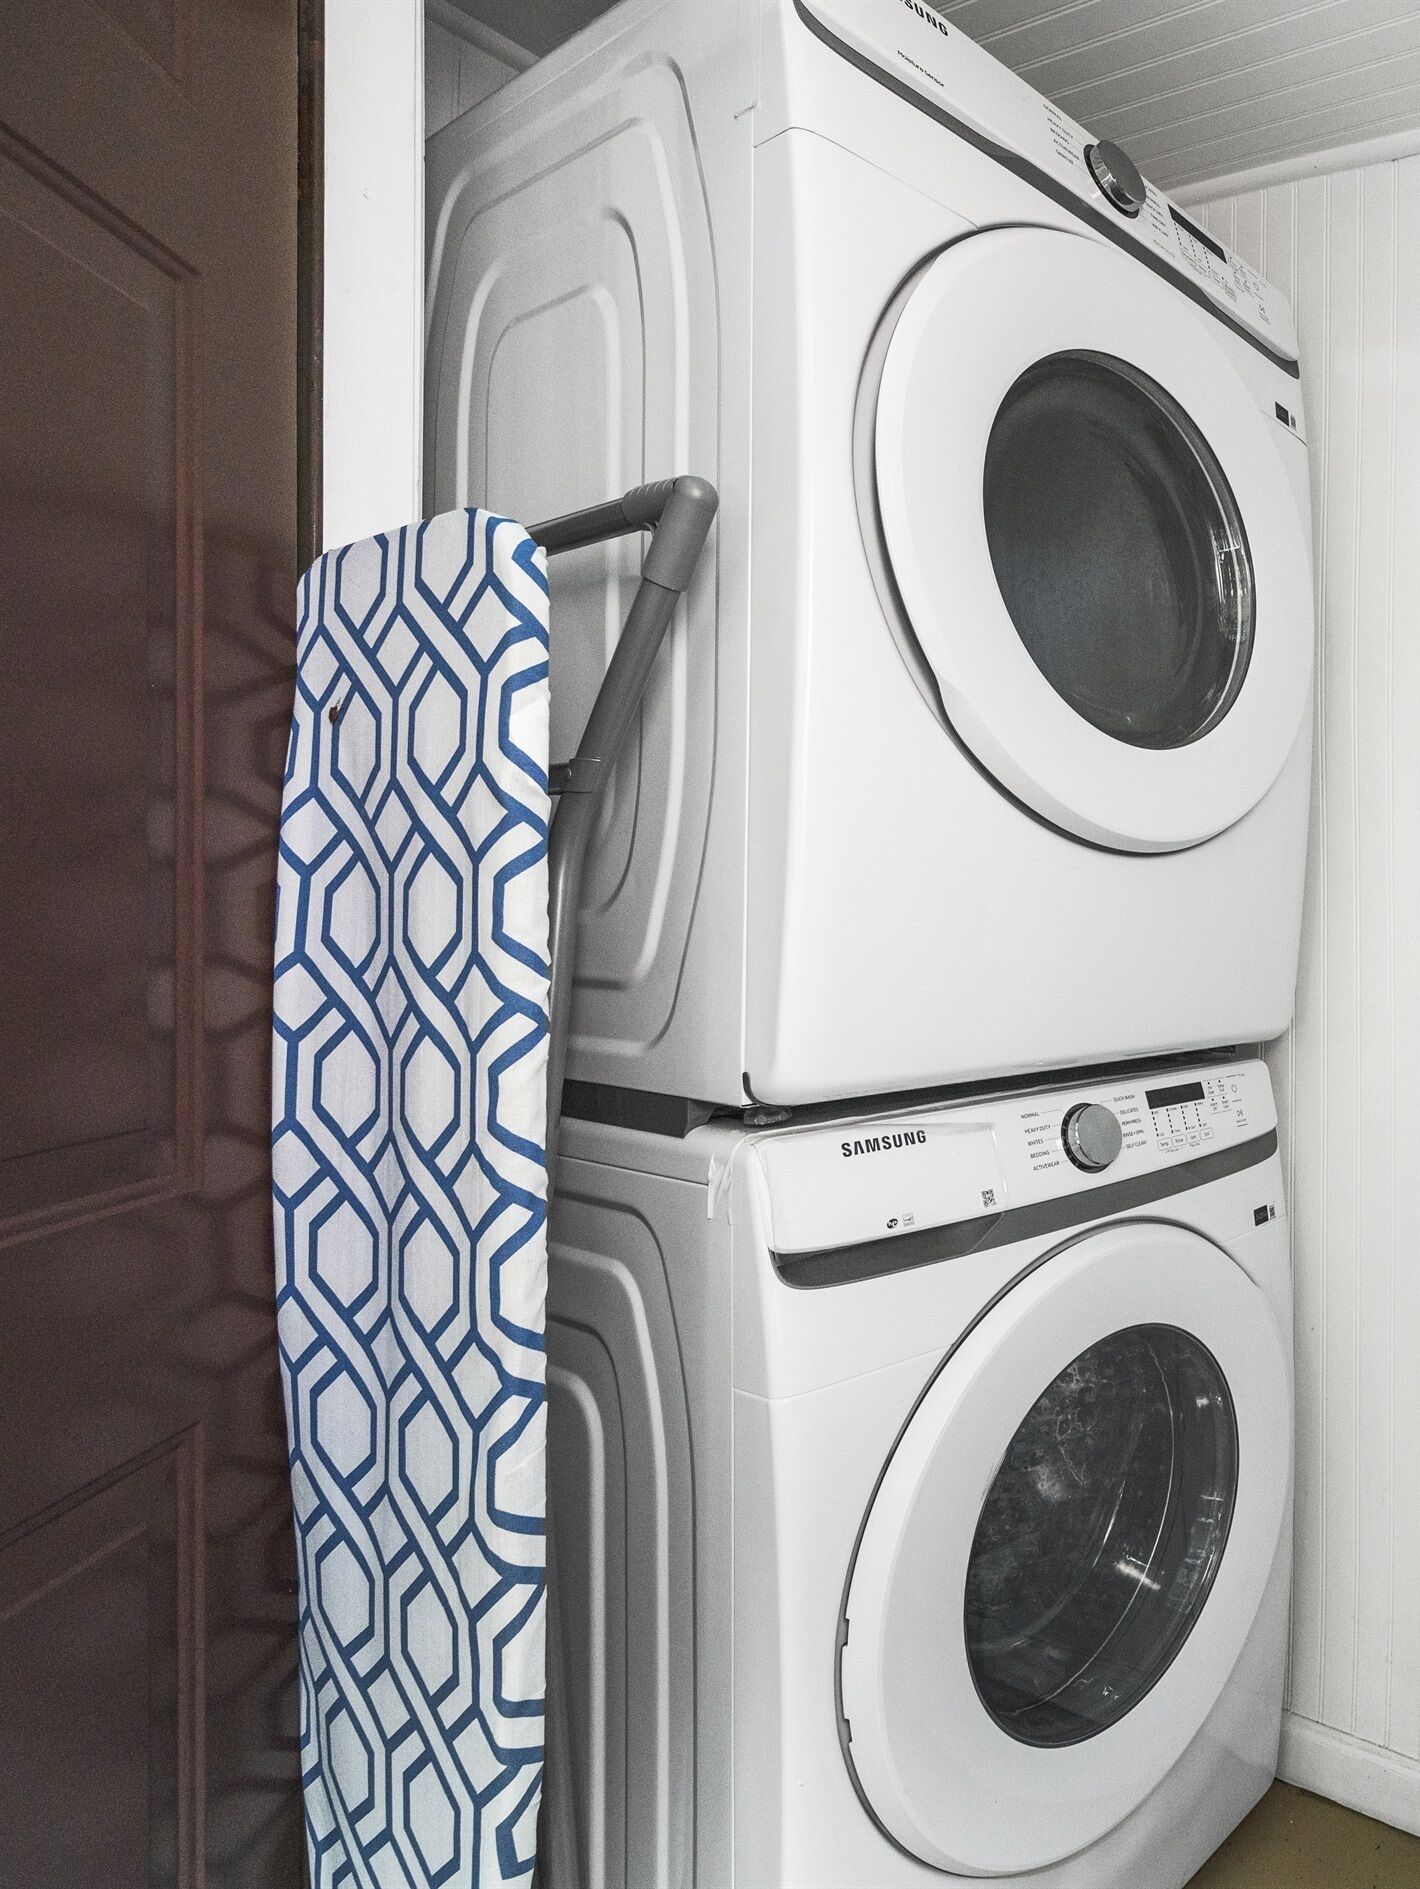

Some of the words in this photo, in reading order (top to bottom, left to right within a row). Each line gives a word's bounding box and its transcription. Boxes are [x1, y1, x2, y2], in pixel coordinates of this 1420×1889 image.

[900, 0, 949, 37] SUNG
[1020, 1111, 1040, 1120] NORMAL
[1024, 1126, 1039, 1135] HEAVY
[1039, 1124, 1051, 1132] DUTY
[840, 1129, 928, 1158] SAMSUNG
[1027, 1138, 1044, 1146] WHITES
[1030, 1150, 1050, 1159] BEDDING
[1033, 1160, 1060, 1171] ACTIVEWEAR
